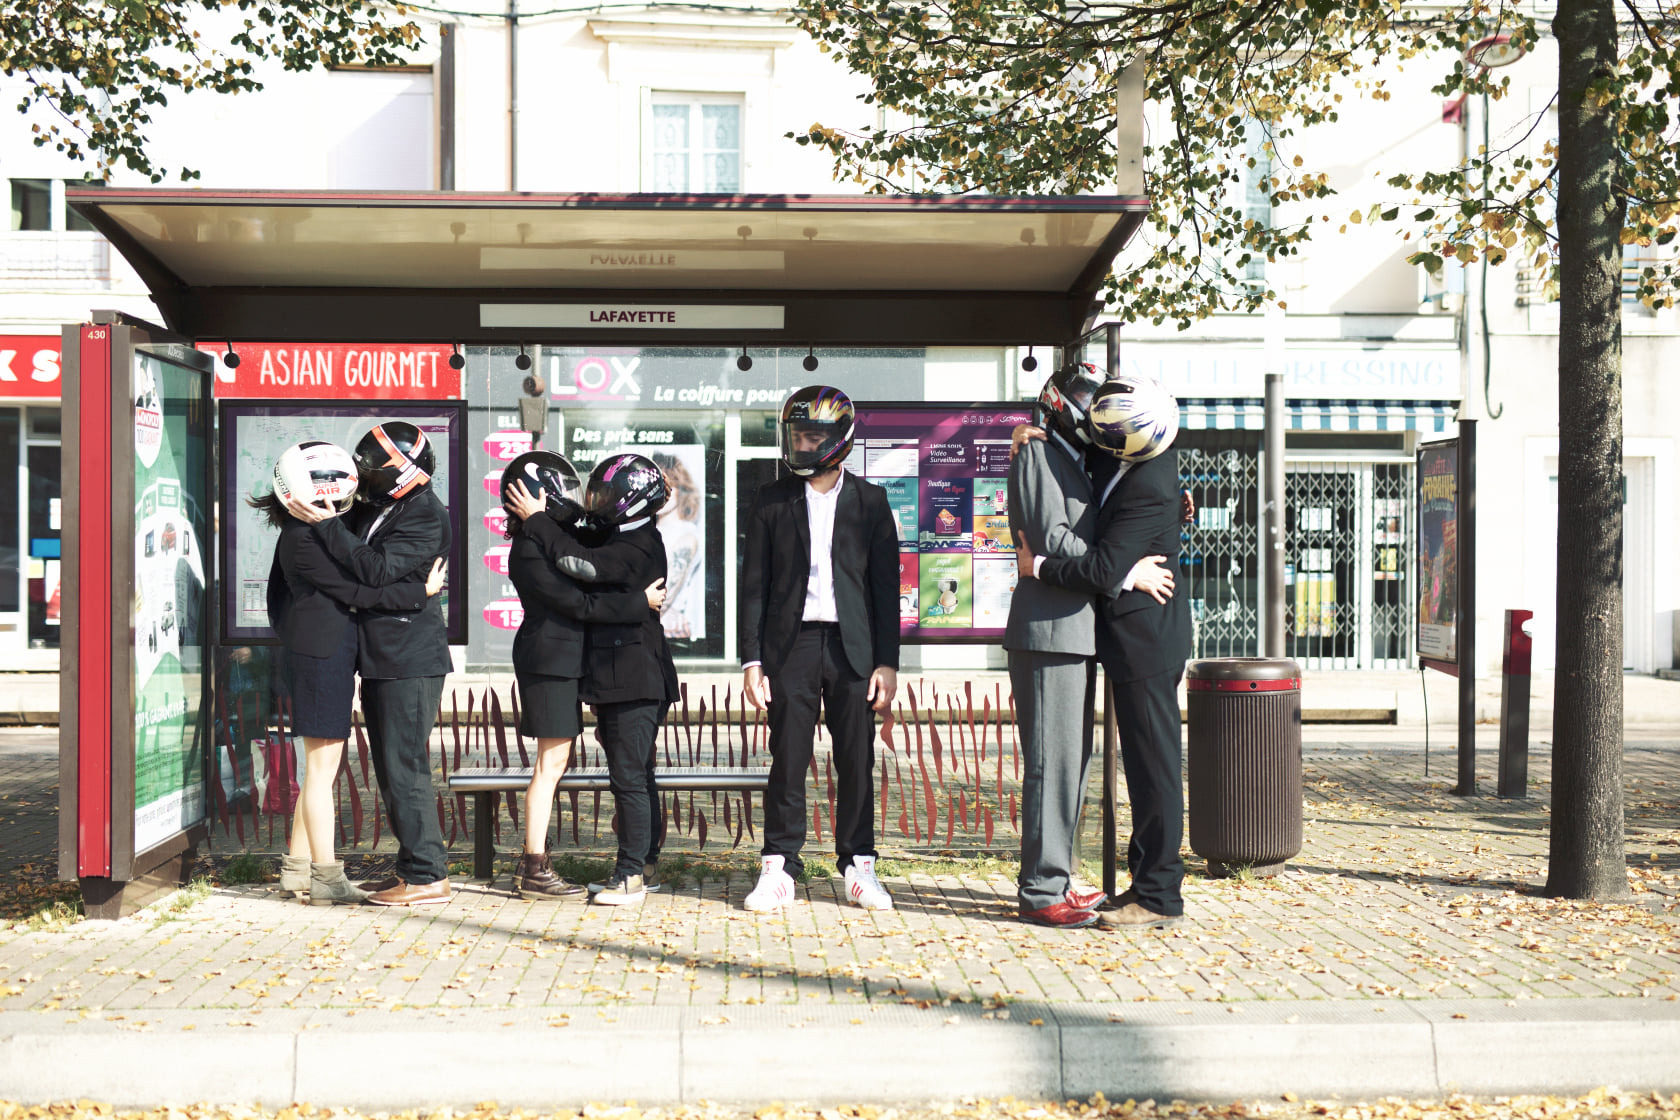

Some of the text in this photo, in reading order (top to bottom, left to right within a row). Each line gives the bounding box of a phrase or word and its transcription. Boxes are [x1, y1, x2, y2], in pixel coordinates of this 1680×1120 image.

[590, 310, 676, 323] LAFAYETTE
[87, 330, 106, 340] 430
[31, 349, 62, 383] S
[259, 349, 440, 388] ASIAN GOURMET
[550, 356, 642, 395] LOX
[654, 385, 675, 402] La
[678, 380, 742, 406] coiffure
[746, 386, 786, 406] pour
[497, 415, 521, 428] ELL
[572, 426, 675, 446] Des prix sans
[315, 486, 341, 496] AIR
